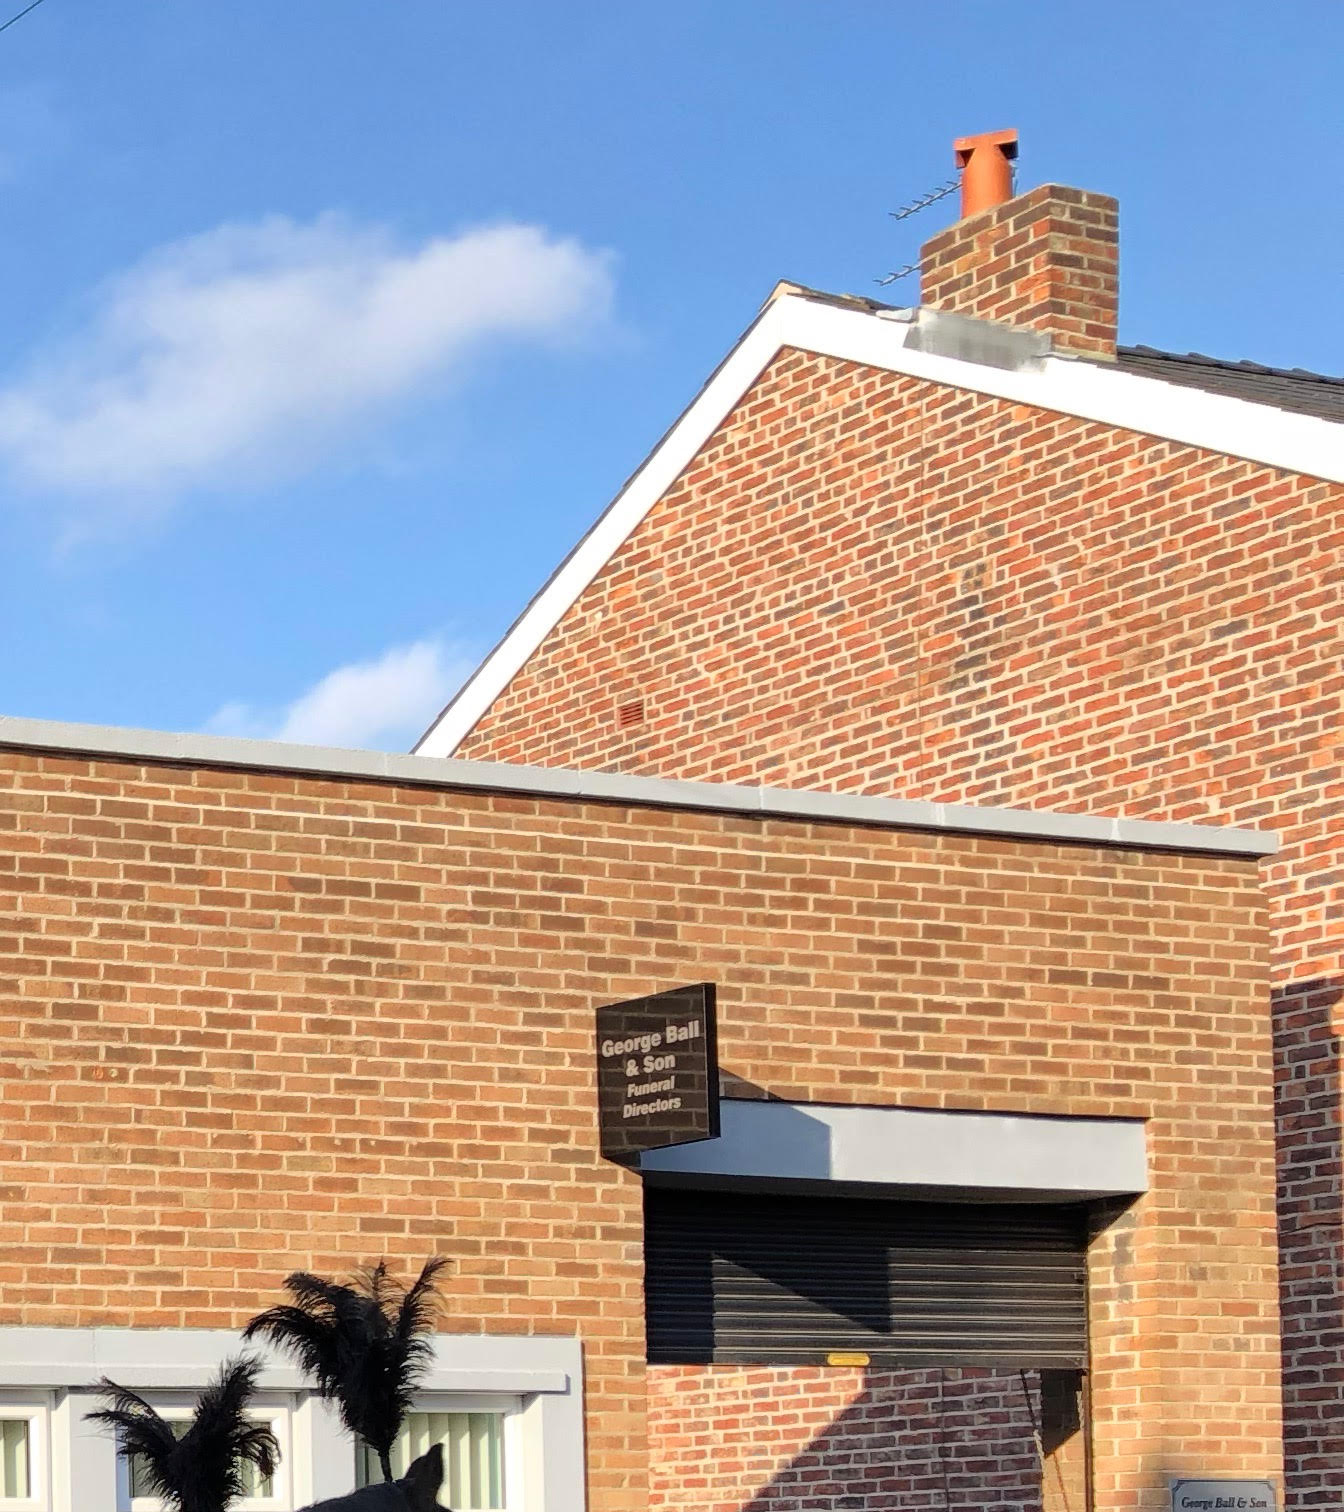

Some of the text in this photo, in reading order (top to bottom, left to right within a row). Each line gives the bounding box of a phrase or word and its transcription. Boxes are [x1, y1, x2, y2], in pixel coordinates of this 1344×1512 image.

[601, 1020, 700, 1057] George Ball
[625, 1054, 676, 1077] & Son
[627, 1075, 675, 1098] Funeral
[622, 1097, 681, 1119] Directors
[1181, 1497, 1213, 1511] George
[1214, 1497, 1235, 1509] Ball
[1249, 1497, 1267, 1509] Son
